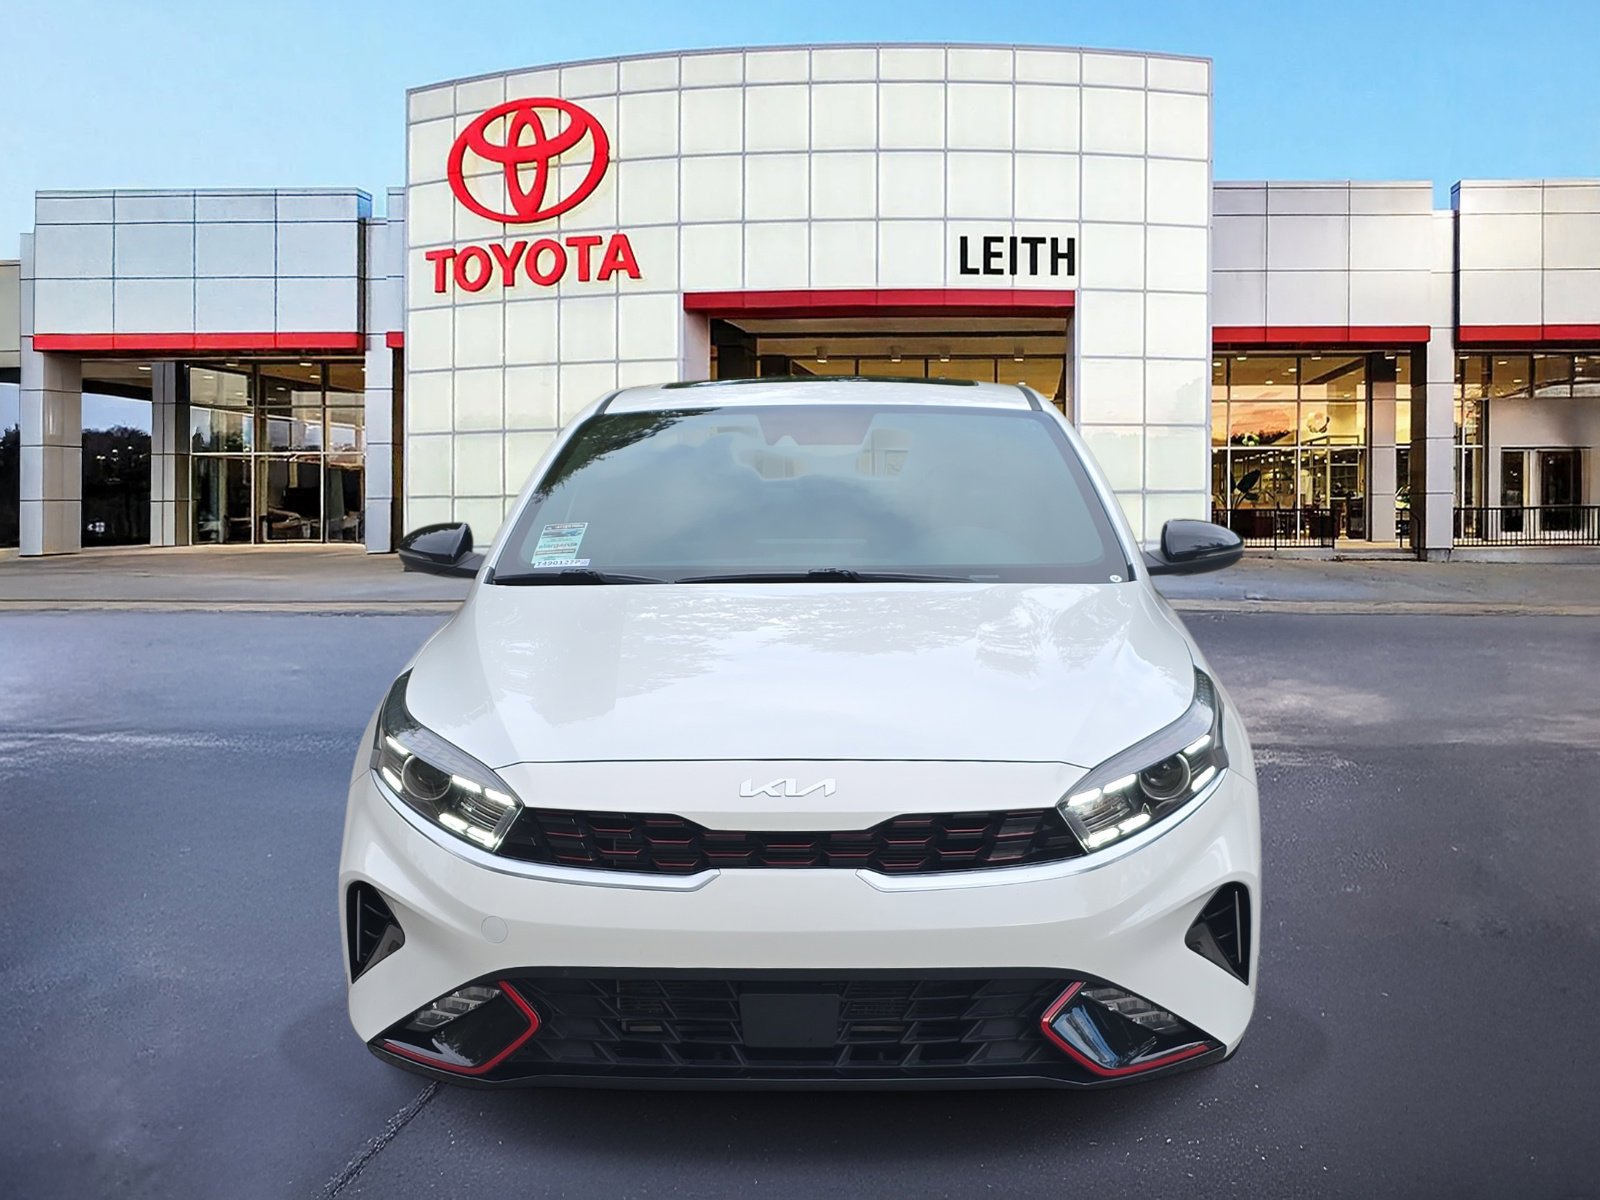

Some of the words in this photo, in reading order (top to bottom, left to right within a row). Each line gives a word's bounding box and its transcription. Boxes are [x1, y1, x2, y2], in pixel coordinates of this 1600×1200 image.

[425, 233, 642, 293] TOYOTA
[960, 236, 1075, 276] LEITH
[739, 778, 837, 798] KIA
